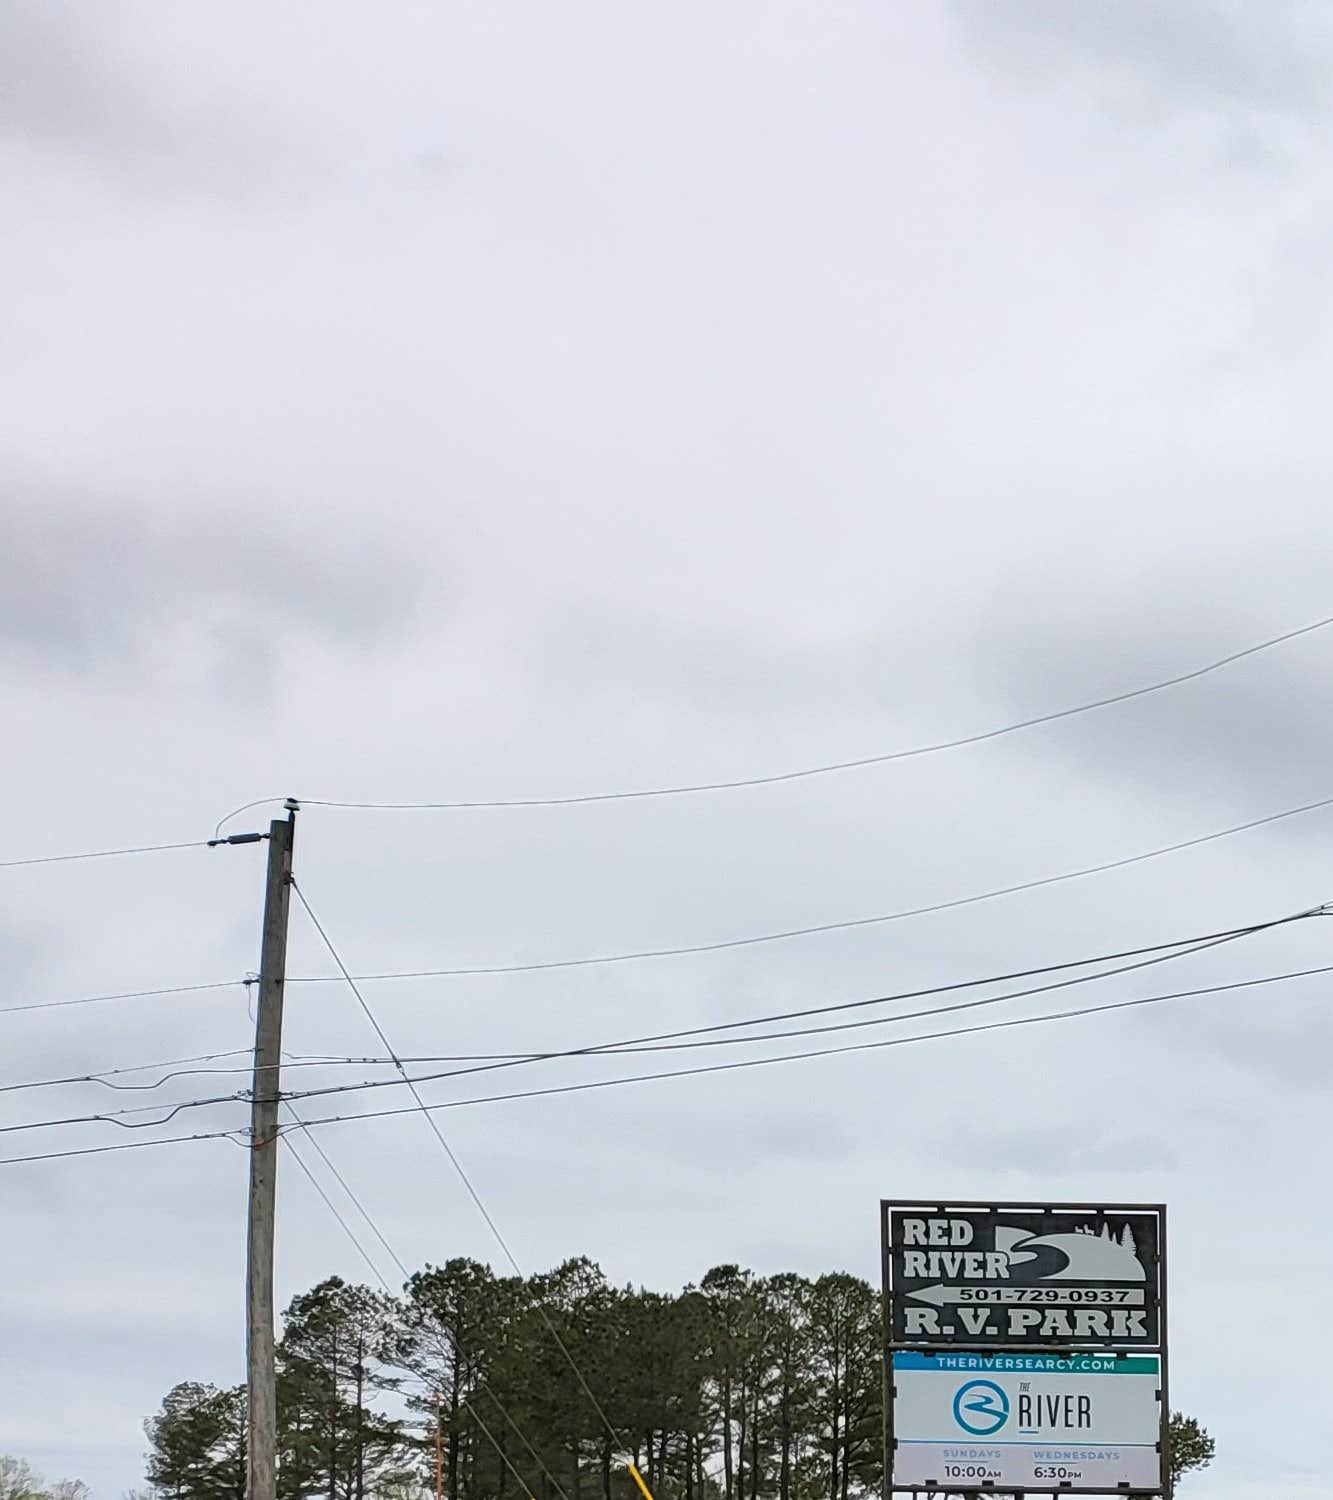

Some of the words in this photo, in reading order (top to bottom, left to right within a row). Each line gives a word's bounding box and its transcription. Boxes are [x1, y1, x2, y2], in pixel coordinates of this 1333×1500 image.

[903, 1219, 974, 1246] RED
[903, 1251, 1010, 1279] RIVER
[959, 1288, 1130, 1303] 501-729-0937
[904, 1307, 999, 1335] R.V.
[1007, 1308, 1148, 1337] PARK
[938, 1357, 1115, 1371] THERIVERSEARCY.COM
[1019, 1382, 1031, 1392] THE
[1018, 1395, 1092, 1429] RIVER
[943, 1449, 1001, 1459] SUNDAYS
[1033, 1451, 1121, 1461] WEDNESDAYS
[944, 1466, 1002, 1478] 10:00AM
[1033, 1466, 1082, 1479] 6:30PM
